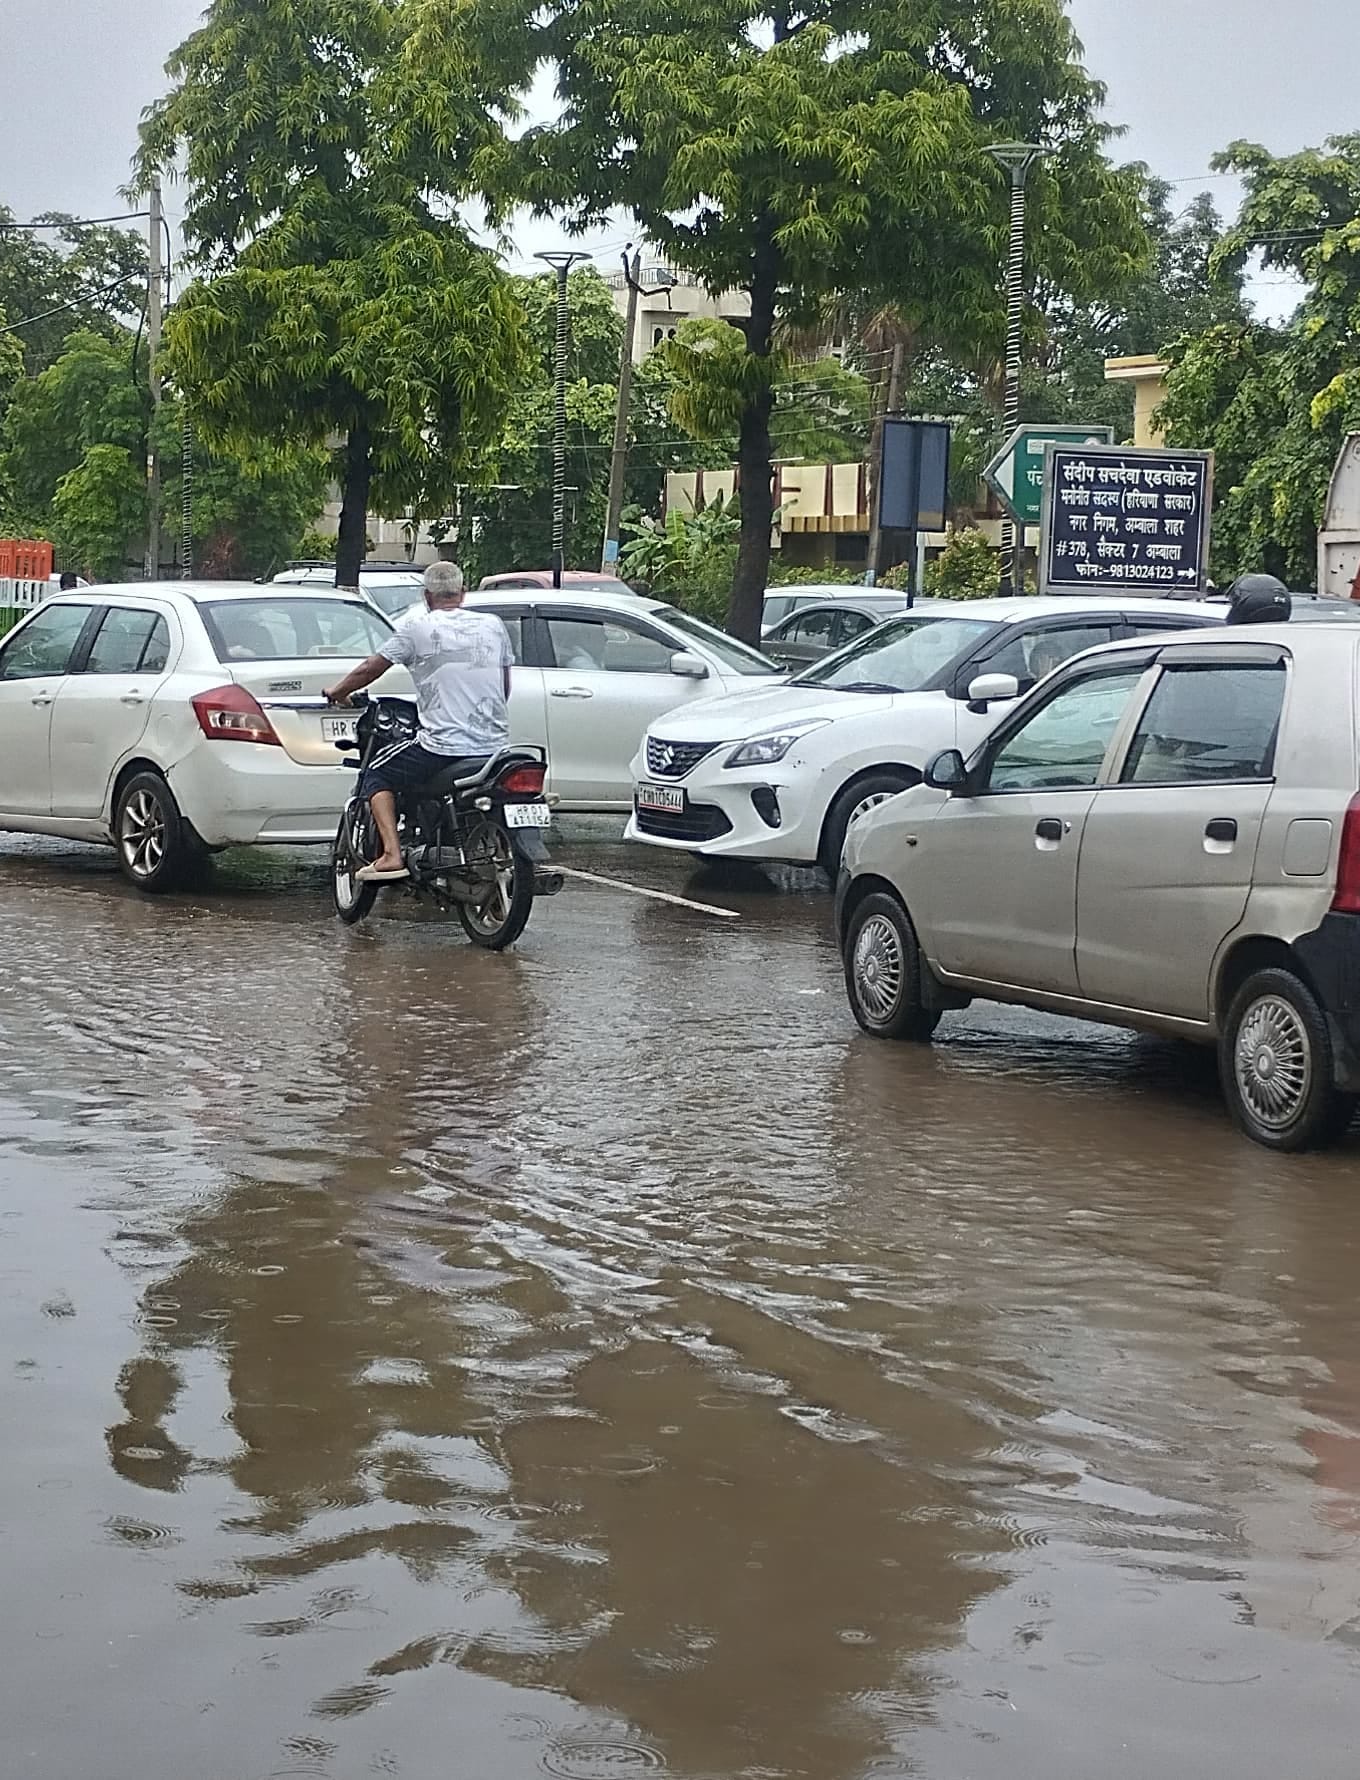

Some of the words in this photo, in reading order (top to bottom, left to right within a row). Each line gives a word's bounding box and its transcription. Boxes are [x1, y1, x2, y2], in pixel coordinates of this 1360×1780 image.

[1063, 461, 1095, 482] संदीप
[1097, 462, 1141, 484] सचदेवा
[1143, 464, 1197, 488] एडवोकेट
[1092, 491, 1120, 507] सदस्य
[1069, 515, 1088, 531] नगर
[1093, 511, 1119, 535] निगम,
[1125, 518, 1158, 534] अम्बाला
[1164, 519, 1185, 536] शहर
[1056, 540, 1090, 559] #378,
[1132, 543, 1139, 559] 7
[1146, 544, 1182, 560] अम्बाला
